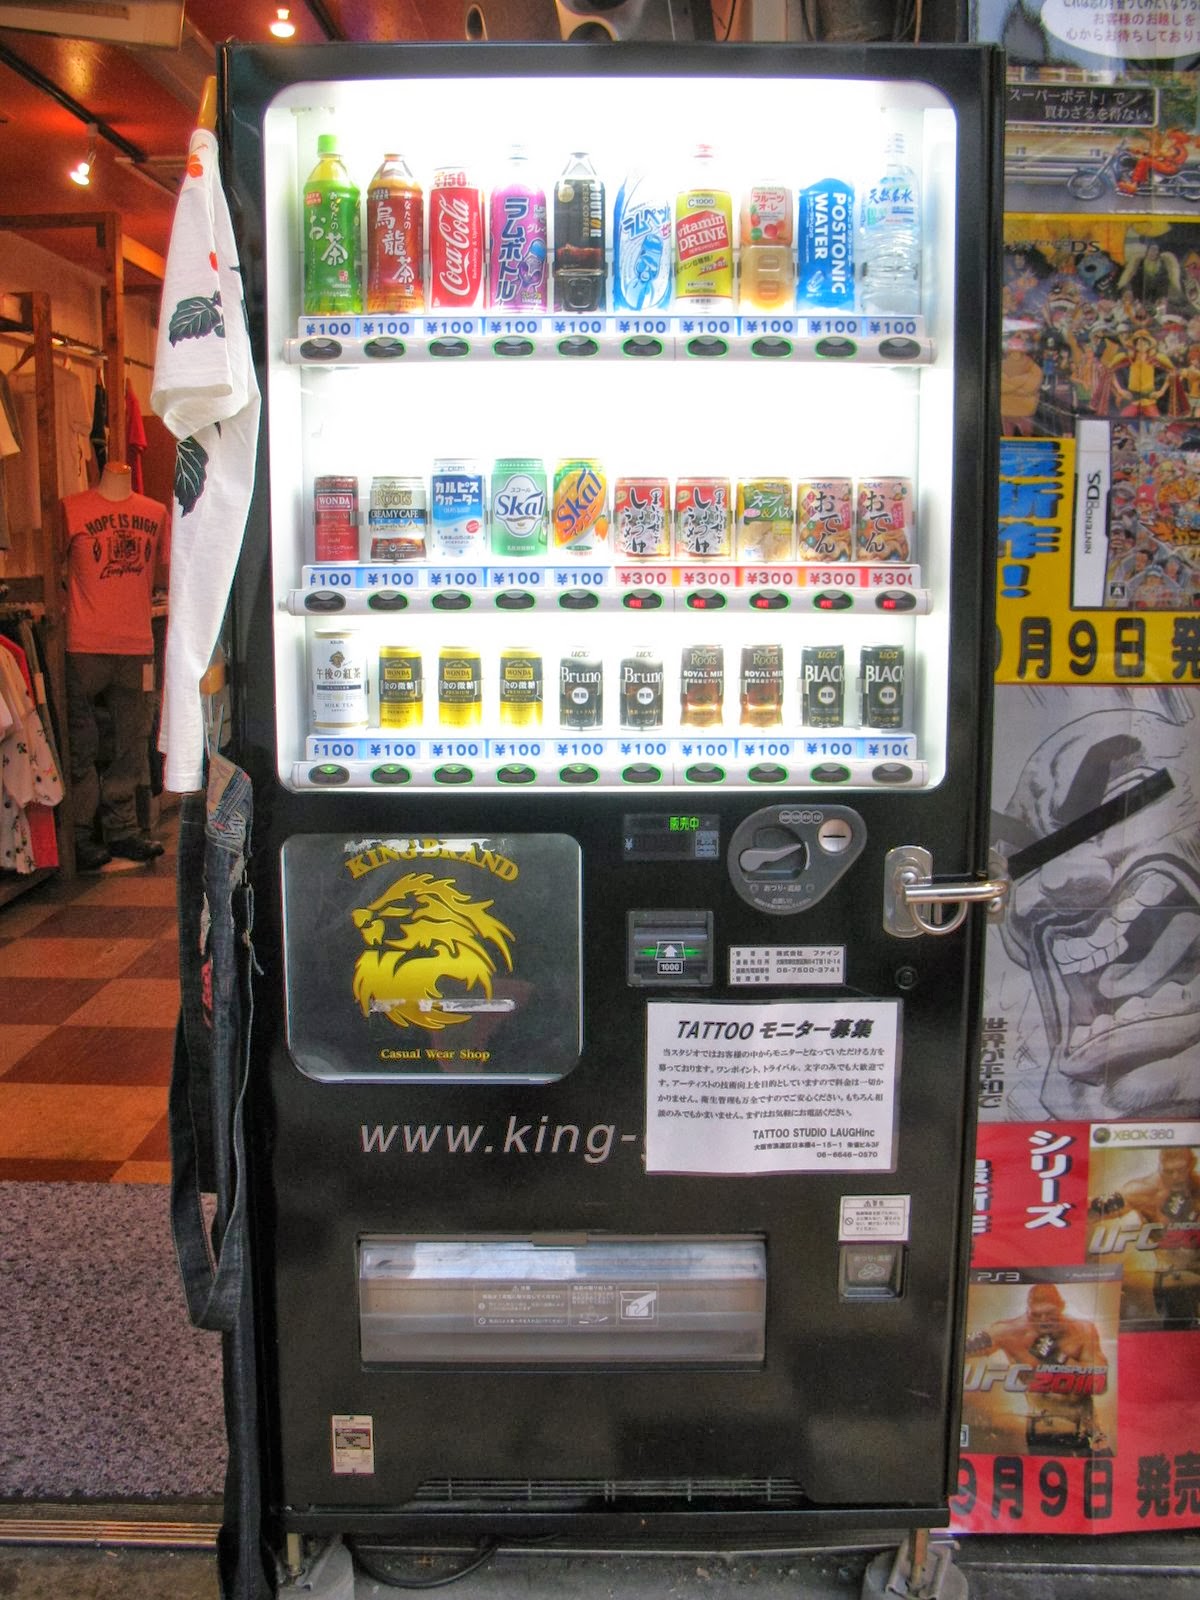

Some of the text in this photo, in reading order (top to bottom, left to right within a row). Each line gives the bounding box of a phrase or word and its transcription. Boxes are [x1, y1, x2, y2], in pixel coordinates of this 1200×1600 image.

[752, 192, 785, 203] フルーツ
[677, 214, 725, 238] vitamin
[814, 193, 829, 260] WATER
[678, 225, 727, 252] DRINK
[831, 192, 847, 294] POSTONIC
[496, 197, 528, 301] ラムボトル
[306, 322, 351, 335] ¥100
[363, 322, 410, 334] ¥100
[426, 322, 473, 334] ¥100
[490, 321, 538, 334] ¥100
[554, 321, 602, 334] ¥100
[620, 320, 666, 334] ¥100
[684, 321, 730, 334] ¥100
[747, 321, 793, 334] ¥100
[811, 321, 858, 334] ¥100
[870, 322, 916, 334] ¥100
[435, 482, 479, 494] カルピス
[1087, 472, 1102, 501] DS
[319, 497, 351, 505] WONDA
[118, 513, 129, 529] IS
[815, 491, 842, 553] おでん
[865, 491, 892, 552] おでん
[368, 574, 414, 585] ¥100
[431, 573, 477, 584] ¥100
[494, 572, 540, 584] ¥100
[557, 573, 603, 585] ¥100
[621, 572, 666, 584] ¥300
[684, 572, 730, 584] ¥300
[748, 572, 793, 584] ¥300
[810, 573, 856, 585] ¥300
[316, 667, 361, 680] 午後の紅茶
[561, 667, 601, 683] Bruno
[684, 670, 708, 678] ROYAL
[744, 670, 770, 678] ROYAL
[370, 744, 416, 756] ¥100
[432, 744, 478, 756] ¥100
[495, 744, 541, 756] ¥100
[558, 744, 604, 756] ¥100
[620, 744, 667, 756] ¥100
[682, 744, 728, 756] ¥100
[744, 744, 790, 756] ¥100
[807, 744, 852, 756] ¥100
[669, 816, 700, 832] 販売中
[345, 838, 520, 882] KING BRAND
[660, 961, 680, 972] 1000
[677, 1018, 875, 1041] TATTOO モニター募集
[380, 1048, 491, 1061] Casual Wear Shop
[360, 1115, 646, 1164] www.king-
[752, 1129, 790, 1140] TATTOO
[793, 1127, 828, 1138] STUDIO
[1112, 1129, 1175, 1141] XBOX 360
[1024, 1130, 1076, 1230] シリーズ
[1088, 1210, 1165, 1255] UFC
[976, 1271, 1021, 1282] PS3
